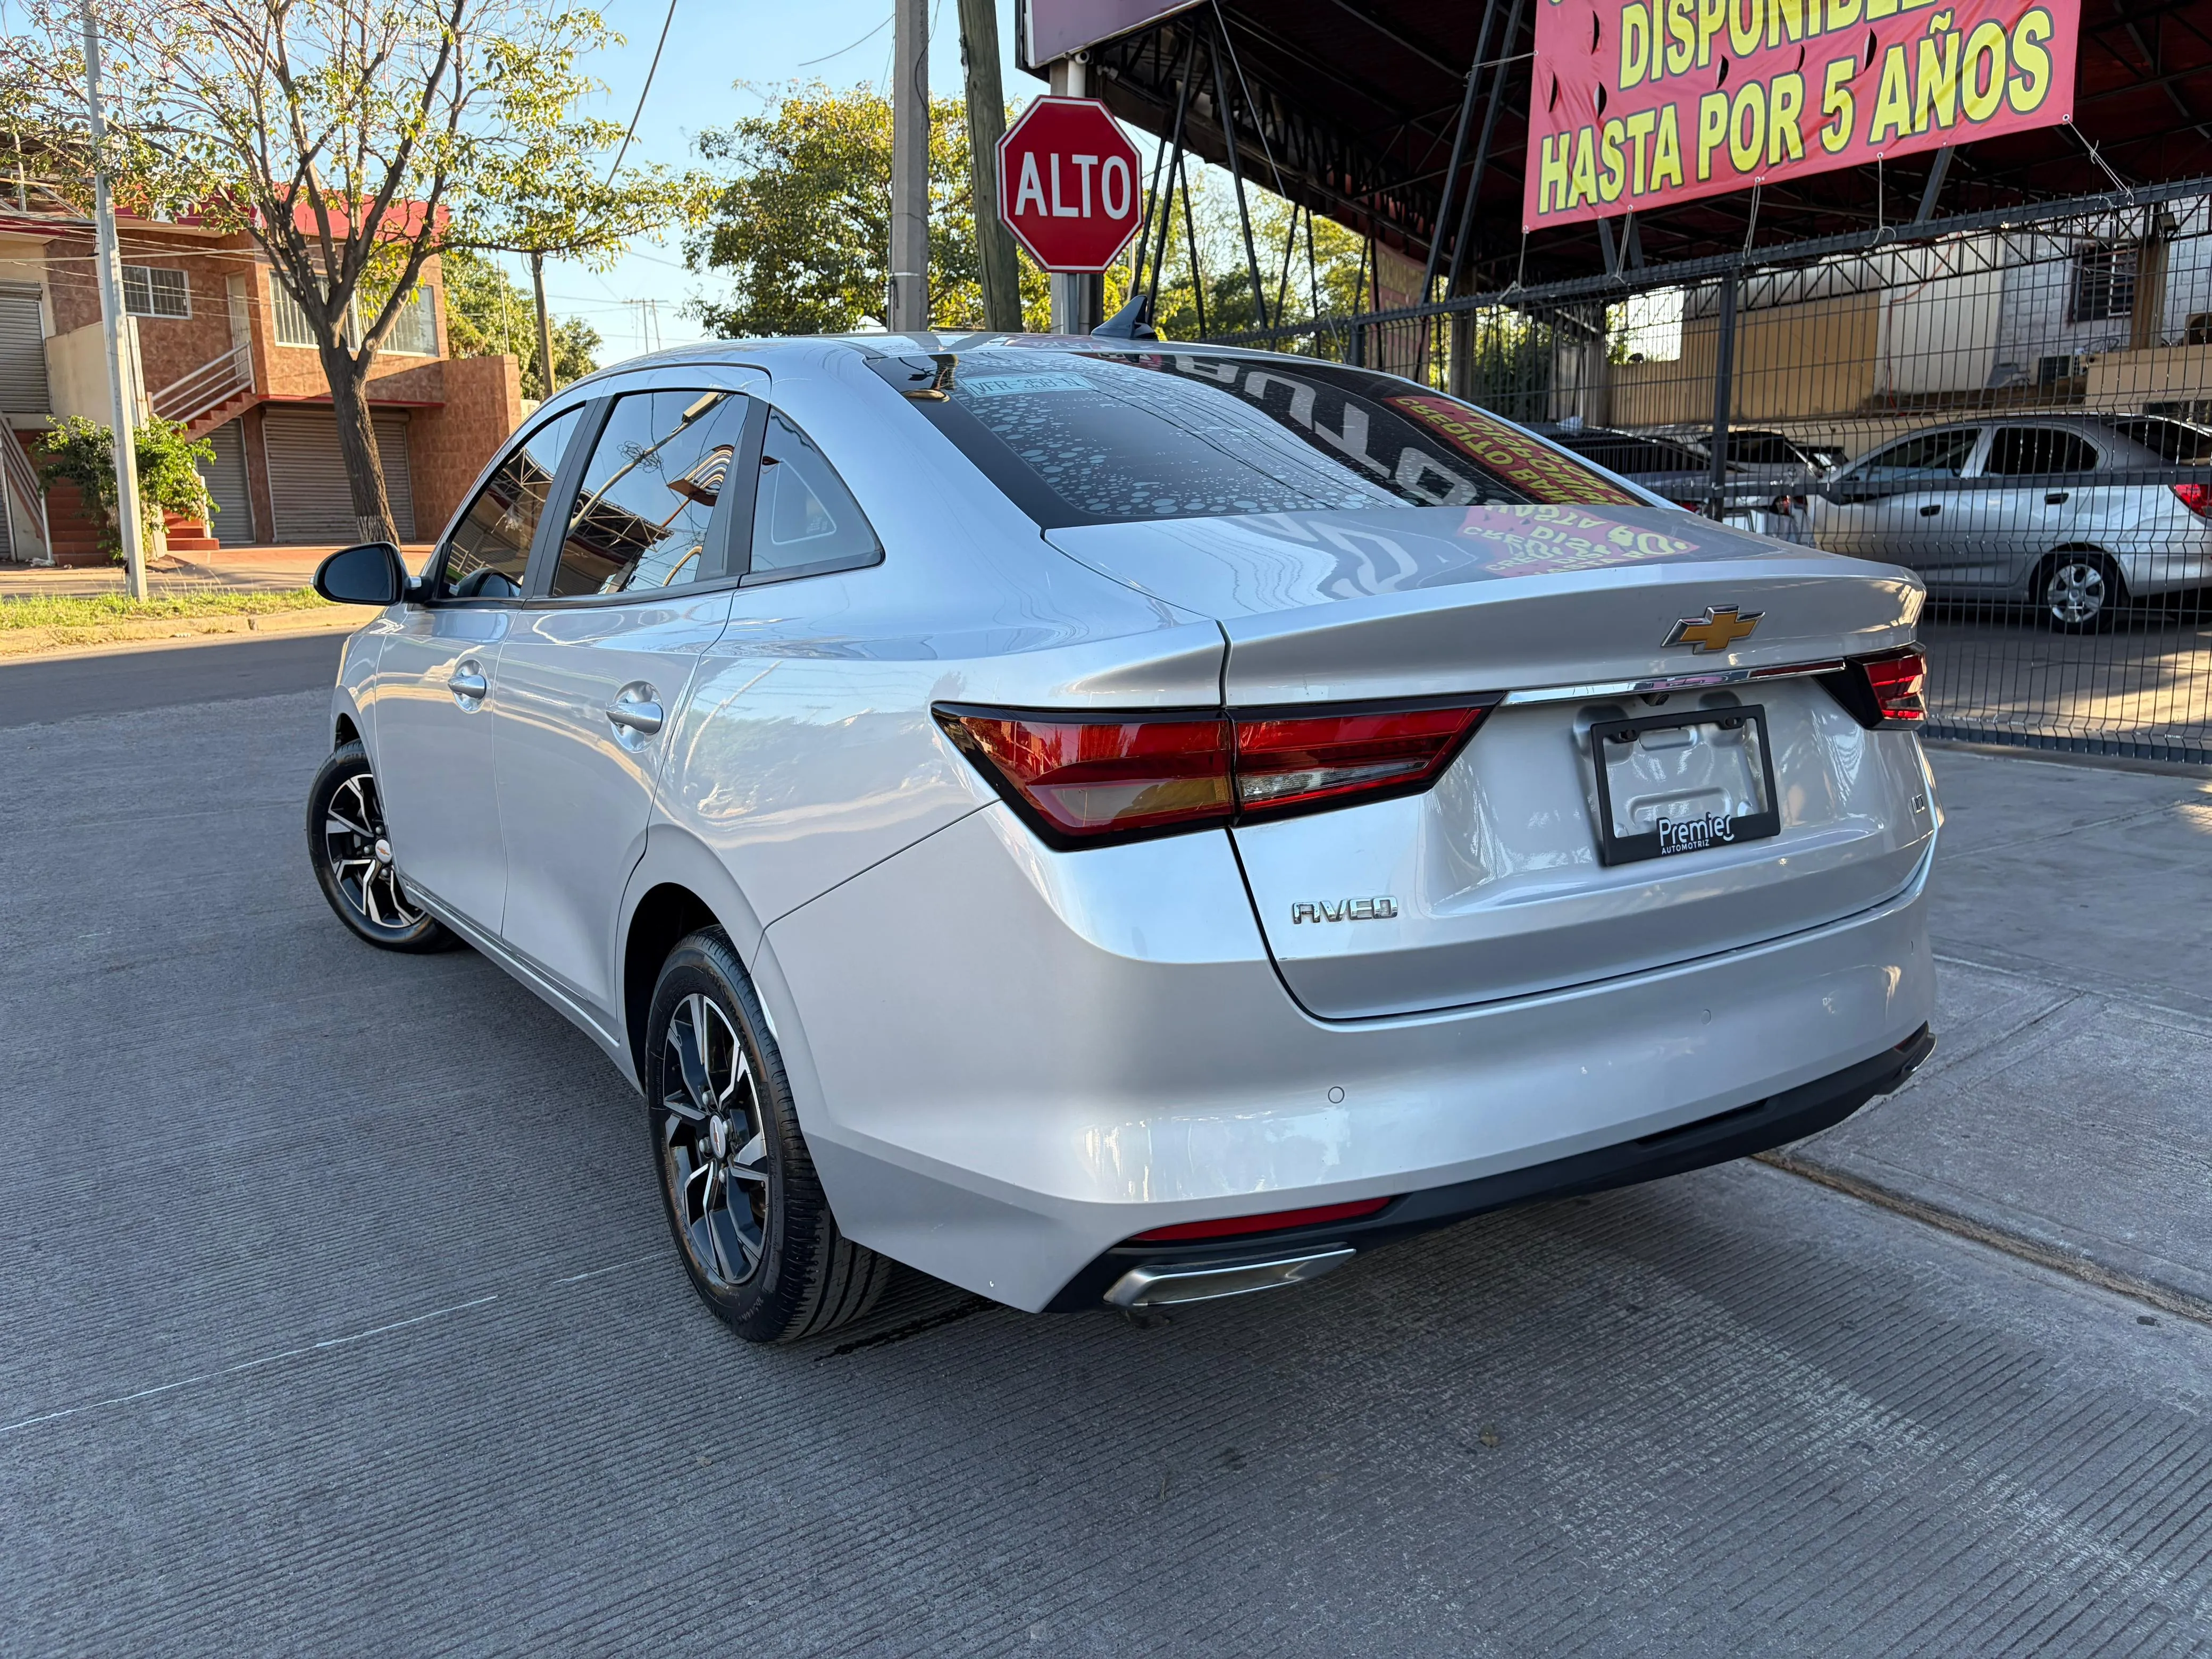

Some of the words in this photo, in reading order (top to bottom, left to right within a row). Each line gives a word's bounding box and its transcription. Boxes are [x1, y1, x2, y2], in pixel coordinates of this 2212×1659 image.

[1618, 0, 1937, 91] DISPON
[1539, 102, 1685, 215] HASTA
[1696, 70, 1806, 182] POR
[1819, 54, 1857, 155] 5
[1867, 6, 2054, 145] AÑOS
[1015, 151, 1131, 220] ALTO
[1659, 813, 1733, 847] Premier
[1662, 839, 1710, 855] AUTOMOTRIZ
[1293, 895, 1398, 925] AVEO
